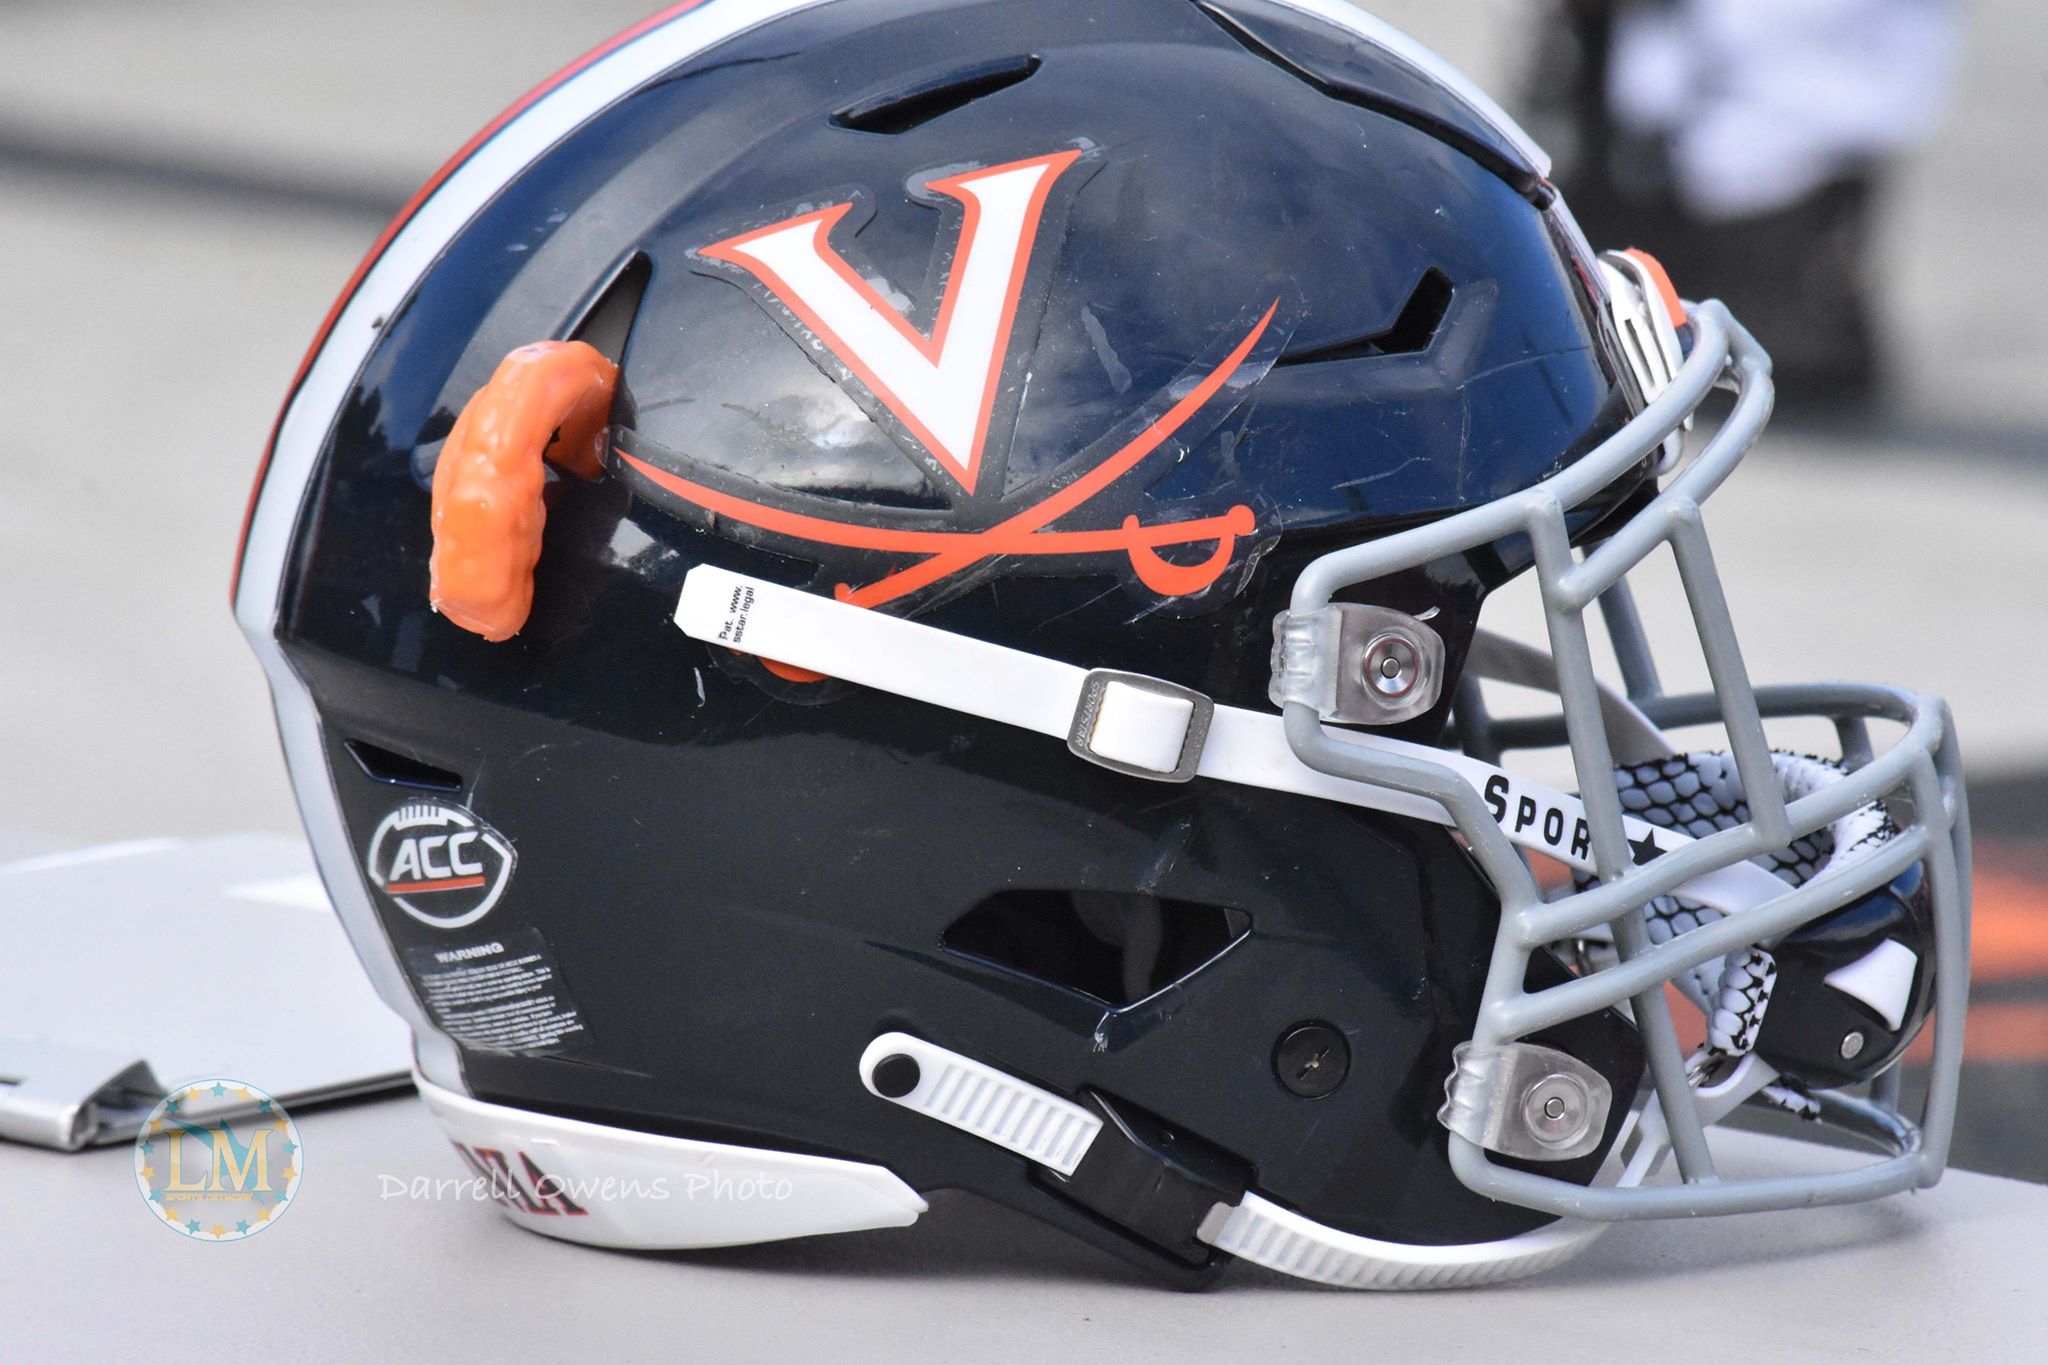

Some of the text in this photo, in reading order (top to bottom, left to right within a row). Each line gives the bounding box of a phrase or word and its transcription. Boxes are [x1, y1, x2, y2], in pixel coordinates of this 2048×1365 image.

[718, 586, 743, 640] Pat. www.
[1484, 774, 1592, 860] SPOR
[389, 831, 483, 881] ACC
[434, 942, 504, 963] WARNING
